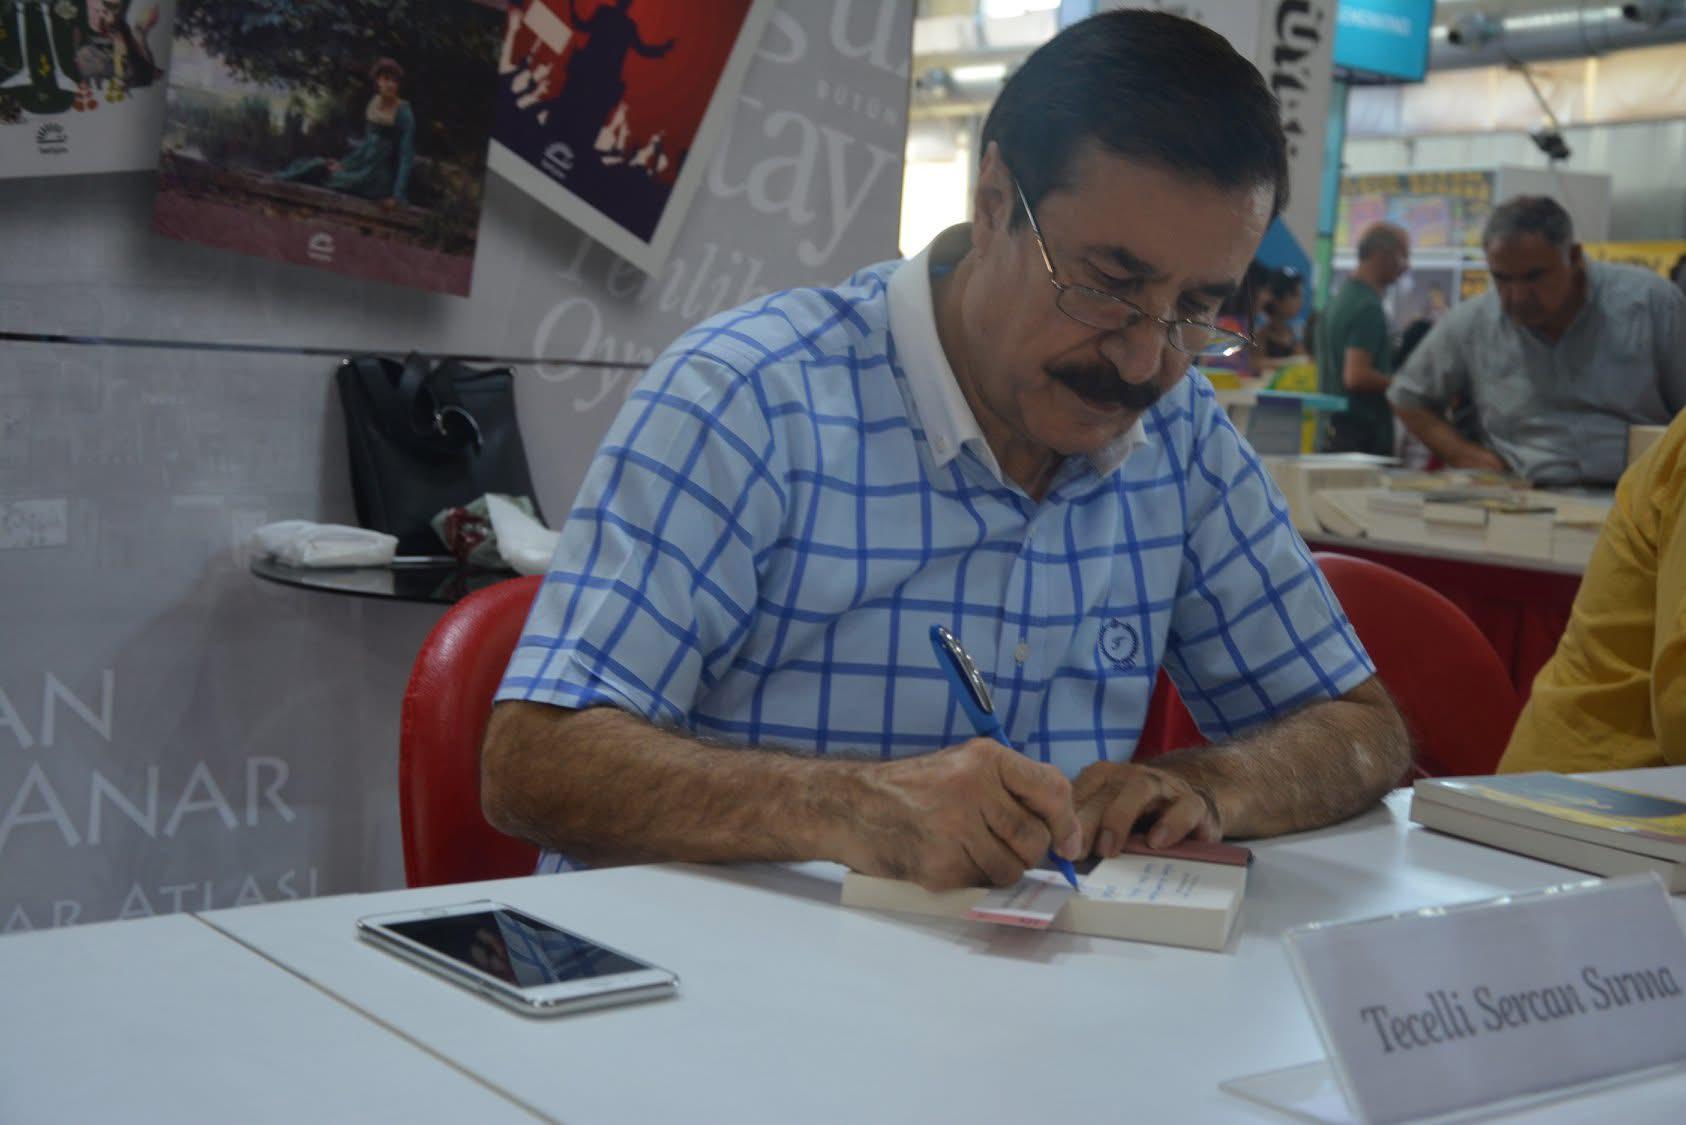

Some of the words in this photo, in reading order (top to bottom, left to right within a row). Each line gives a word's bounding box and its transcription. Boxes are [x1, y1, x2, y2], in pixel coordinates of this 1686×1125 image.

[1361, 989, 1476, 1054] Tecelli
[1475, 985, 1583, 1032] Sercan
[1581, 964, 1682, 1012] Sırma
